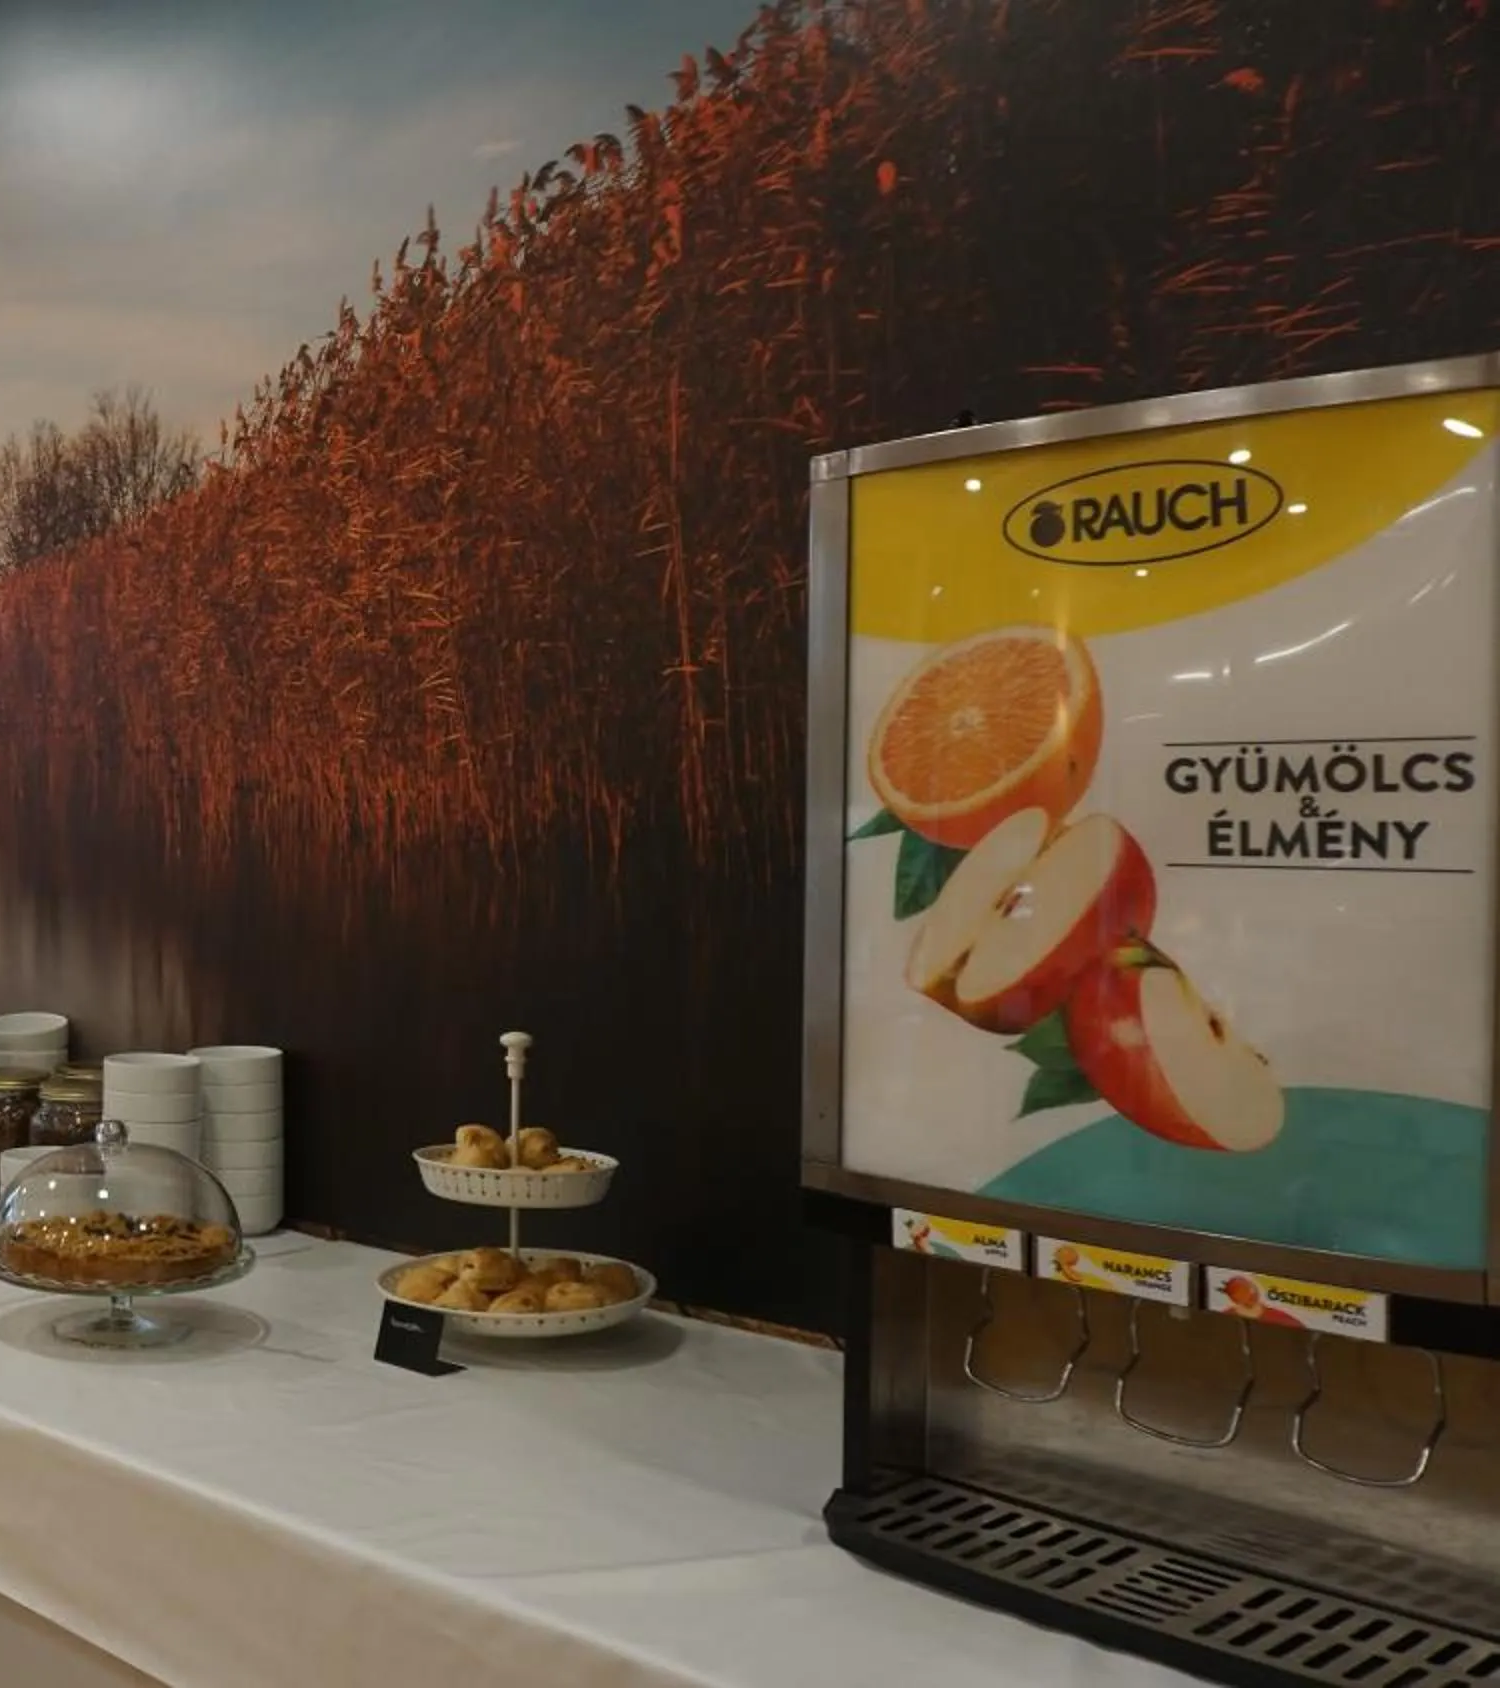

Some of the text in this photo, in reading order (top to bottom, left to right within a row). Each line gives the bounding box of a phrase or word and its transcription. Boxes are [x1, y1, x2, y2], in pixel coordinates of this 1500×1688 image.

[1072, 479, 1248, 542] RAUCH
[1165, 745, 1475, 794] GYÜMÖLCS
[1299, 796, 1320, 818] &
[1208, 809, 1430, 860] ÉLMÉNY
[1102, 1260, 1172, 1282] NARANCS
[1332, 1314, 1368, 1327] PEACH
